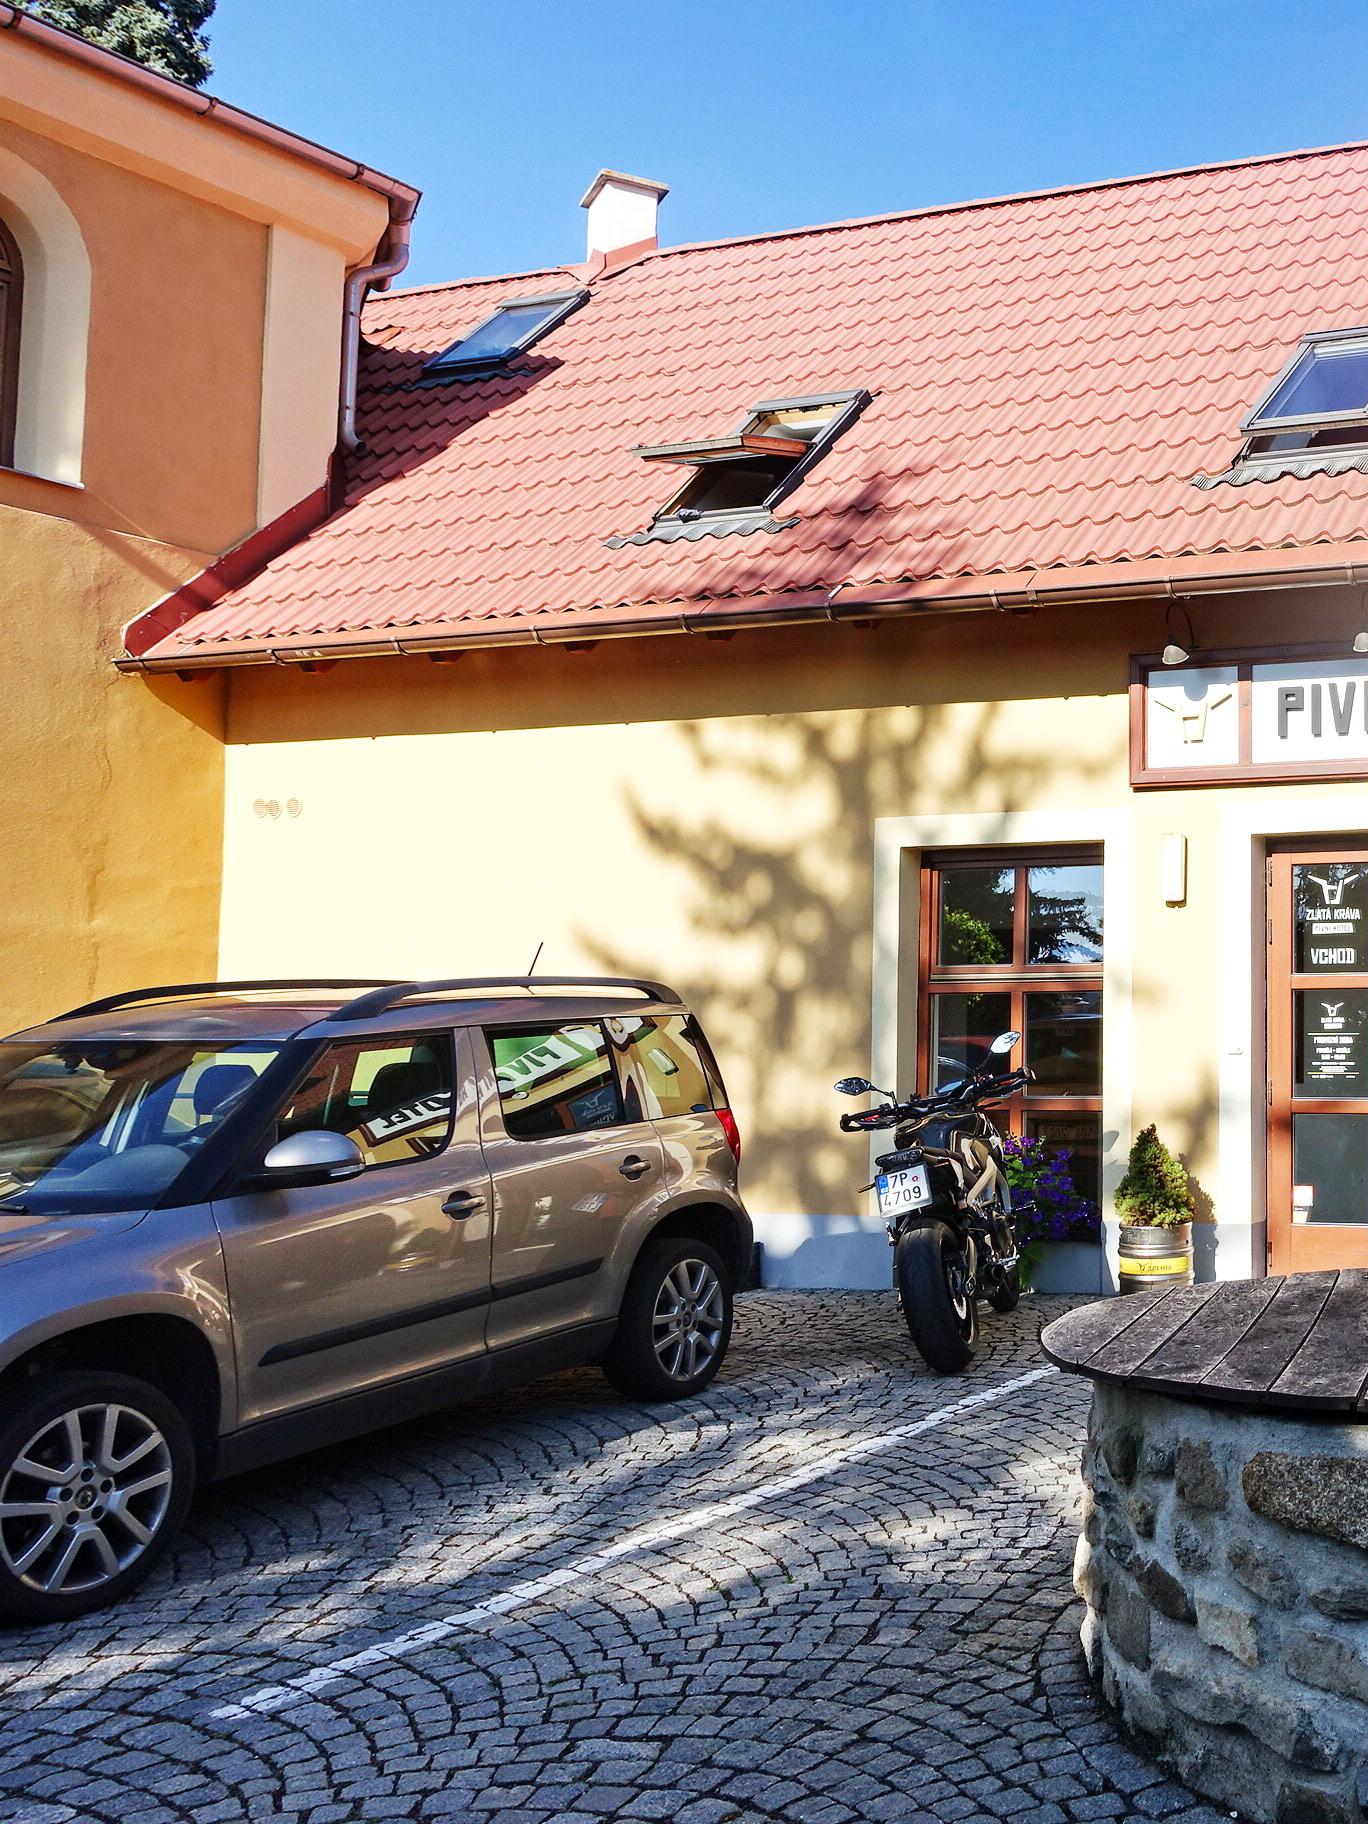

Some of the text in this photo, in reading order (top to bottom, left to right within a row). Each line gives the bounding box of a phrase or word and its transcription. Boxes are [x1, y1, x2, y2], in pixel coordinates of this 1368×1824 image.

[1305, 906, 1361, 920] ZLATÁ KRÁVA
[1310, 947, 1355, 965] VCHOD
[889, 1172, 908, 1189] 7P
[884, 1186, 922, 1207] 4709
